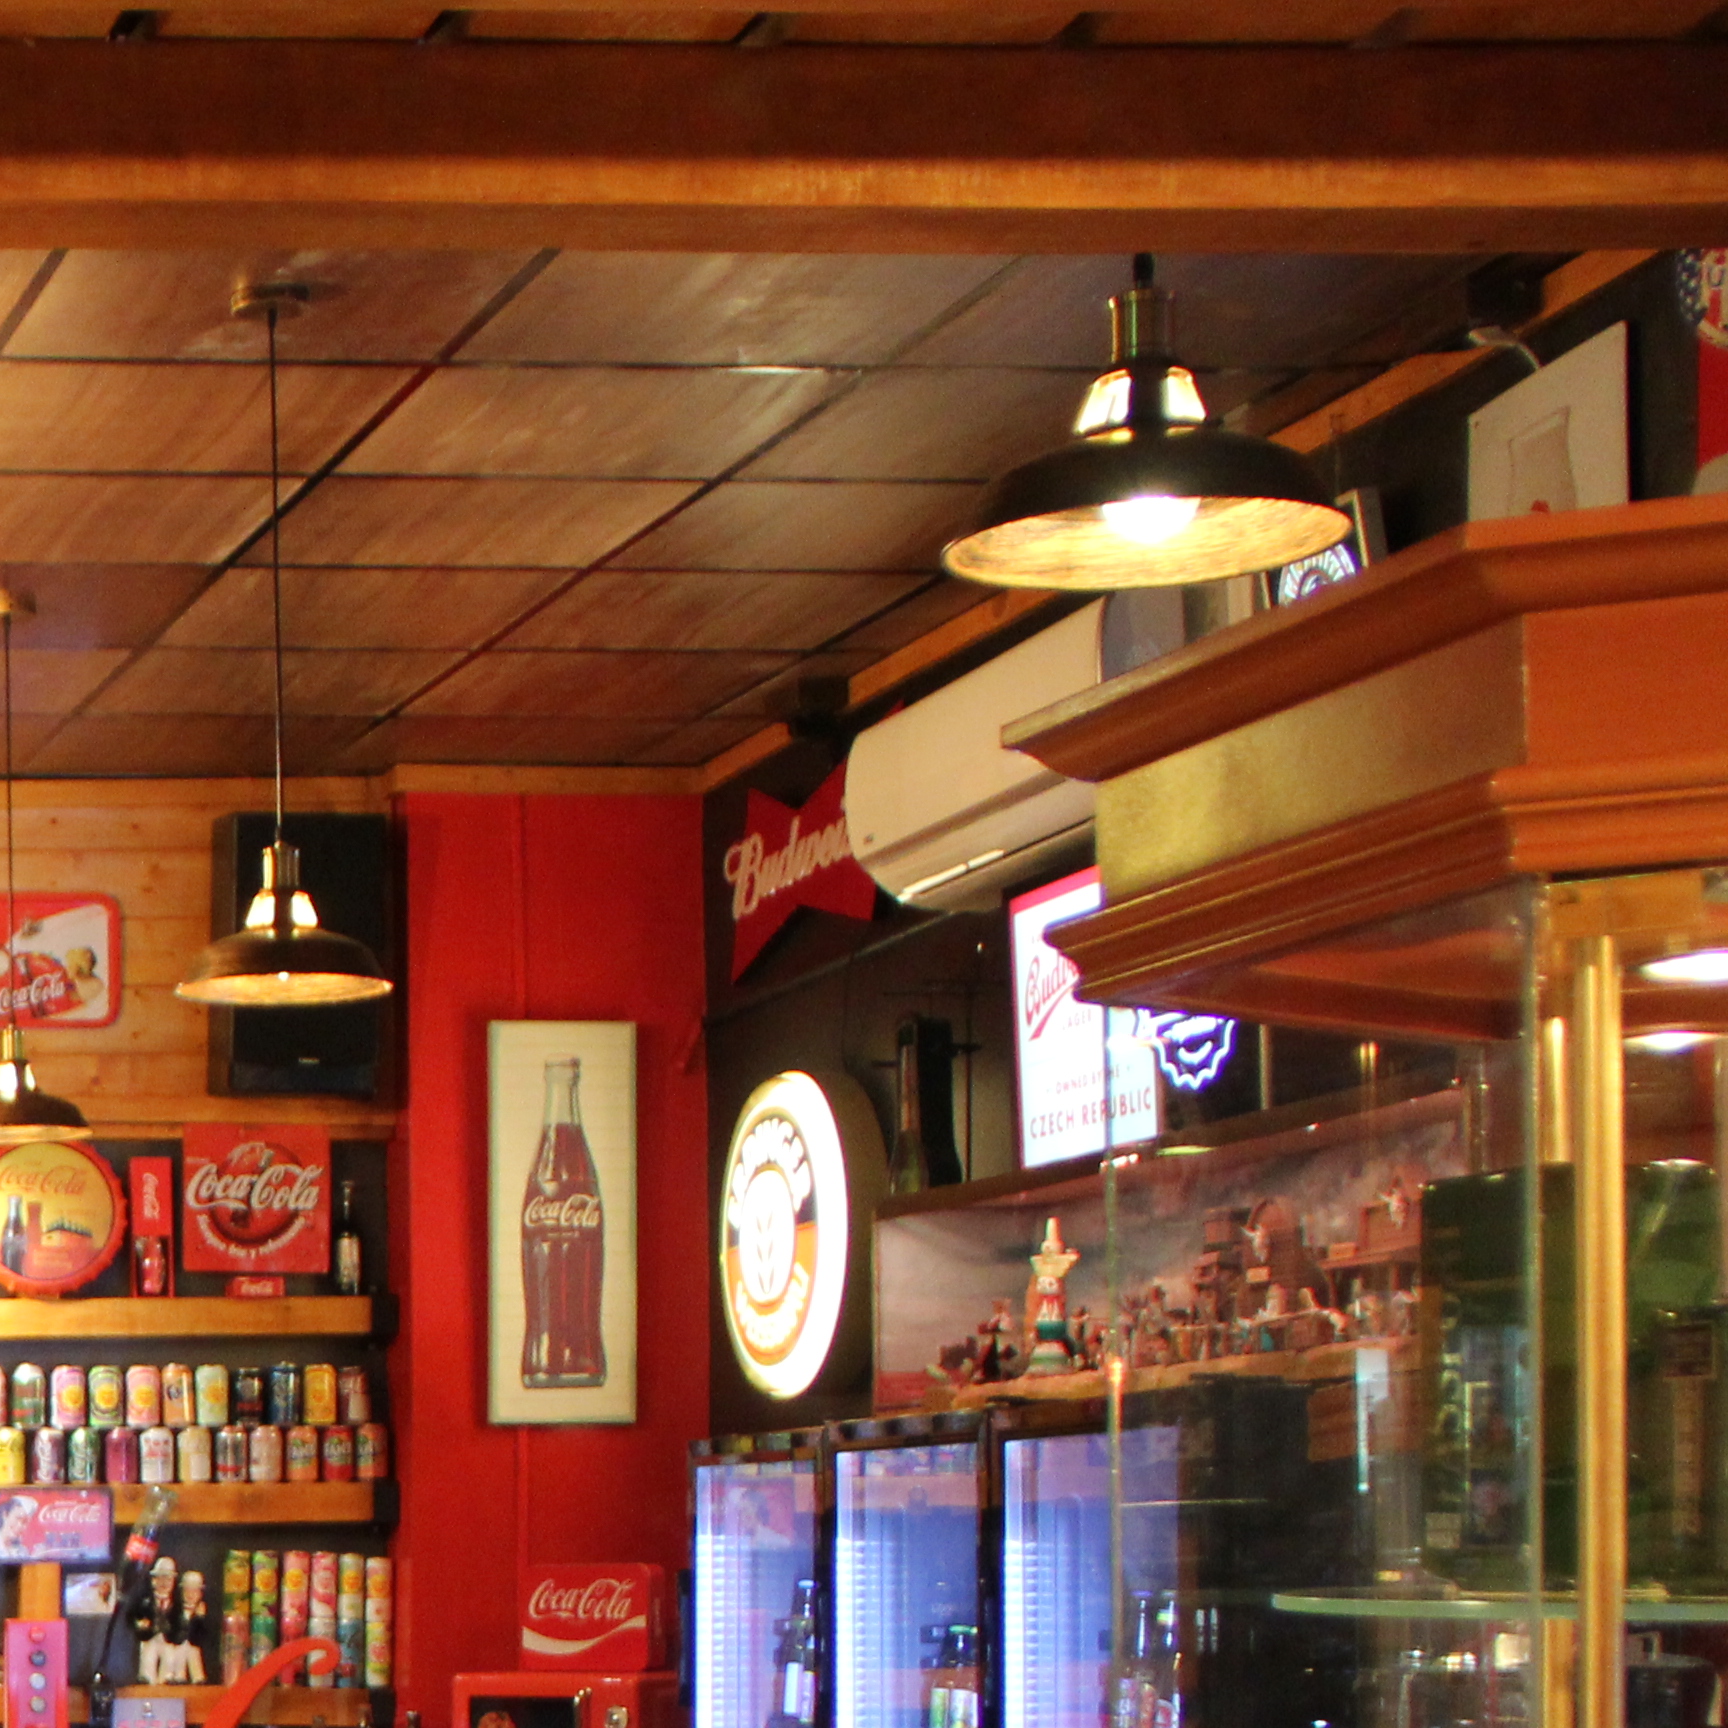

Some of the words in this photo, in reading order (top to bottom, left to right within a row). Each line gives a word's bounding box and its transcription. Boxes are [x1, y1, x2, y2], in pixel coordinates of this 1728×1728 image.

[724, 815, 853, 922] Budwei
[1029, 1109, 1075, 1140] CZECH
[1081, 1087, 1153, 1126] REPUBLIC
[185, 1163, 325, 1212] Coca-Cola
[524, 1192, 601, 1229] Coca-Cola
[529, 1578, 637, 1620] Coca-Cola
